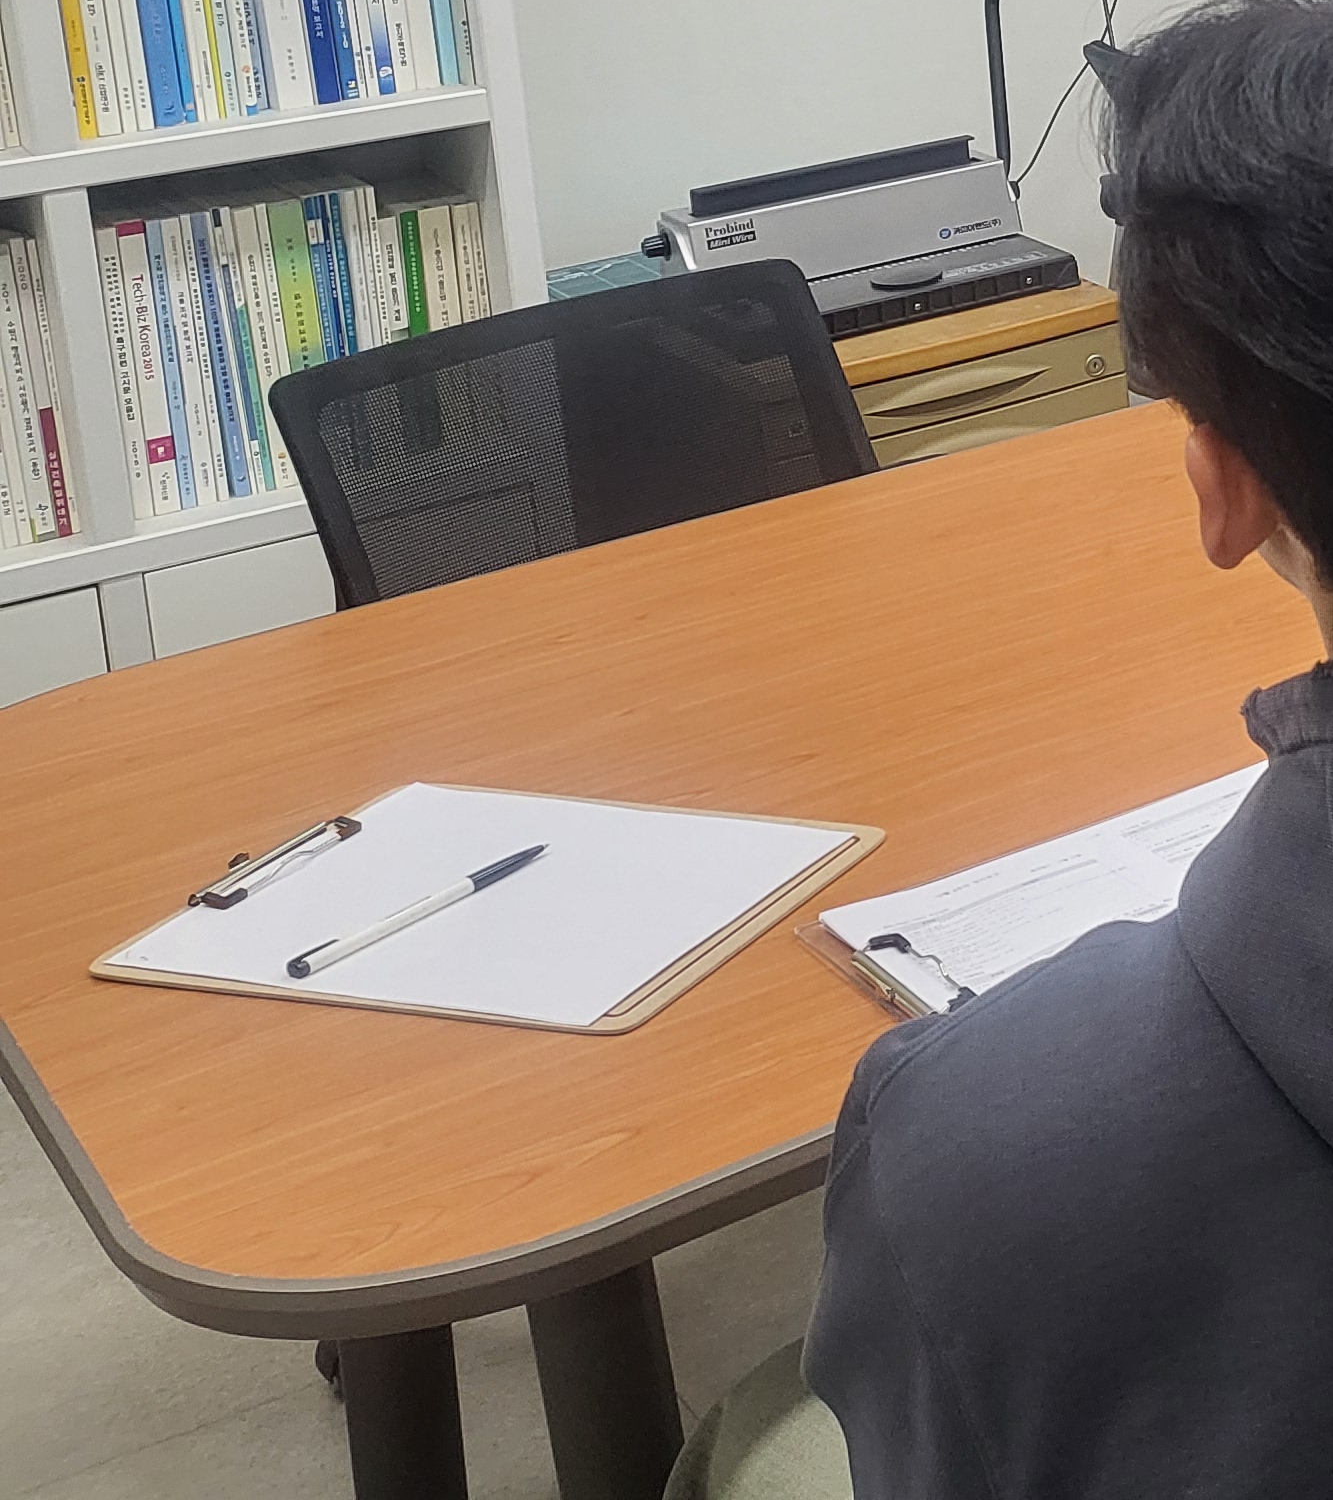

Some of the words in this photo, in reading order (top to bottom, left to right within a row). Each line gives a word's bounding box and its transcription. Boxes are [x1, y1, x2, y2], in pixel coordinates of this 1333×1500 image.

[704, 217, 755, 239] Probind
[709, 237, 731, 249] Mini
[731, 233, 754, 244] Wire
[131, 273, 149, 324] Tech-Biz
[138, 323, 152, 358] Korea
[142, 357, 155, 381] 2015
